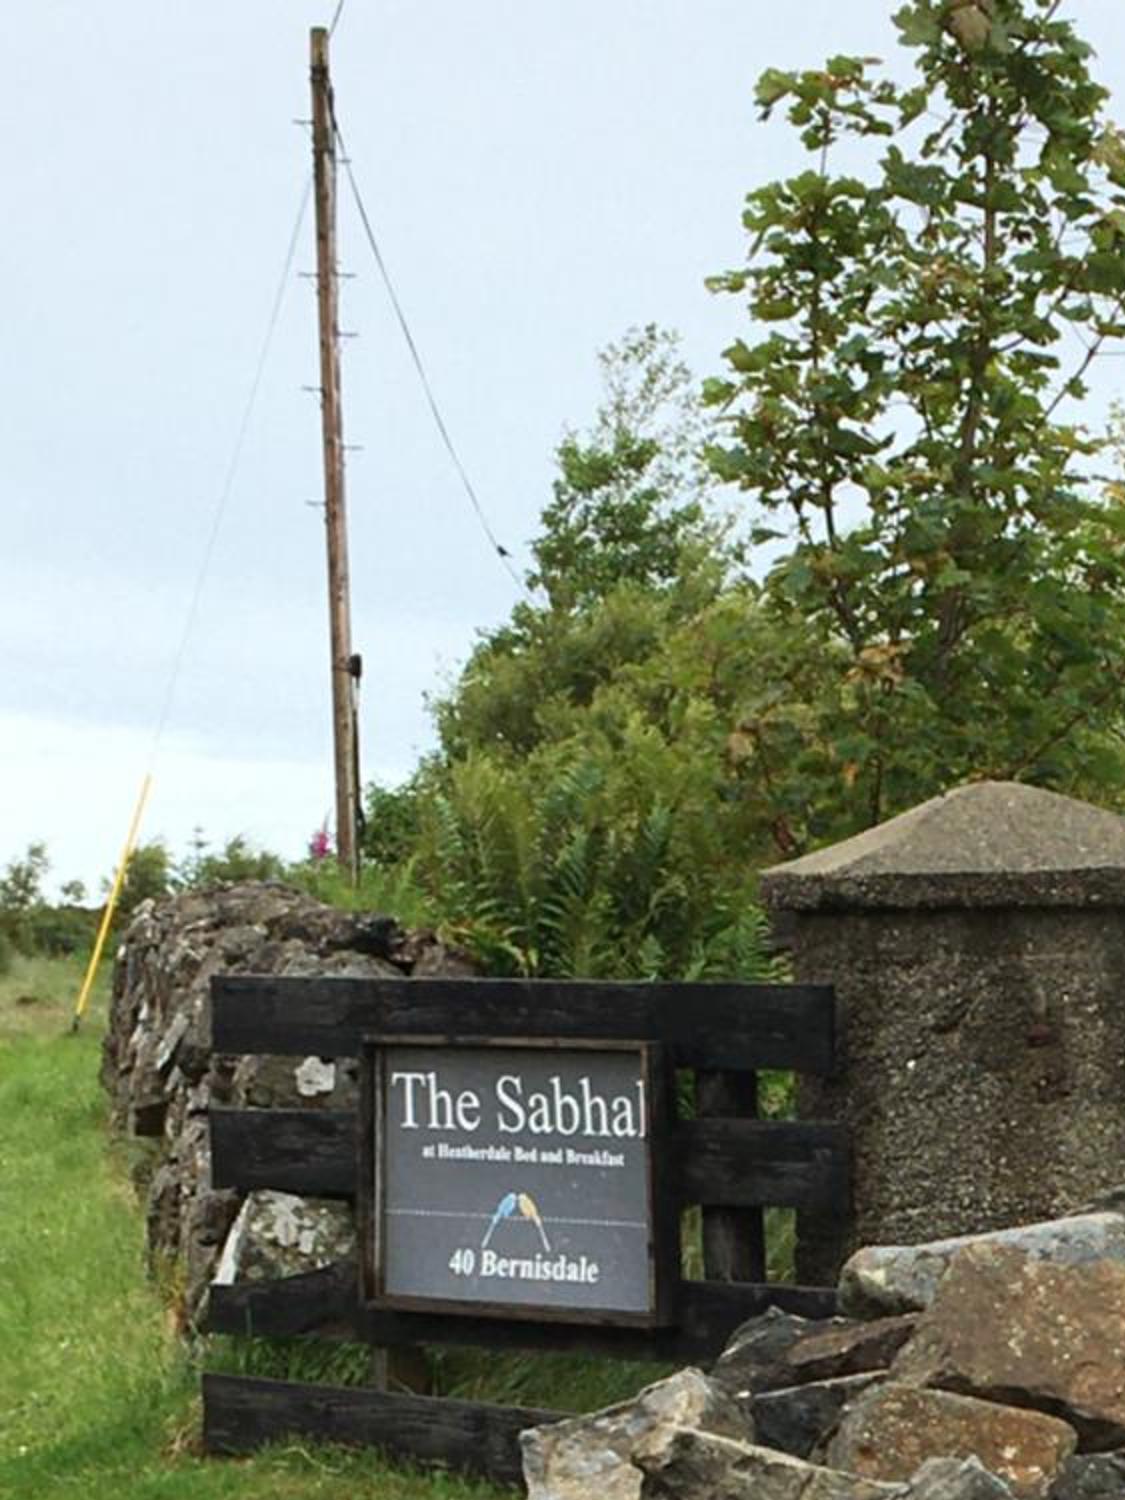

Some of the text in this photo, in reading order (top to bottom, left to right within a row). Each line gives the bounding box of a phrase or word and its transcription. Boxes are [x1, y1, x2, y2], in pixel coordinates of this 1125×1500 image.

[391, 1071, 647, 1138] The Sabhal
[422, 1144, 625, 1167] at Heatherdale Bed and Breakfast
[449, 1248, 600, 1284] 40 Bernisdale
